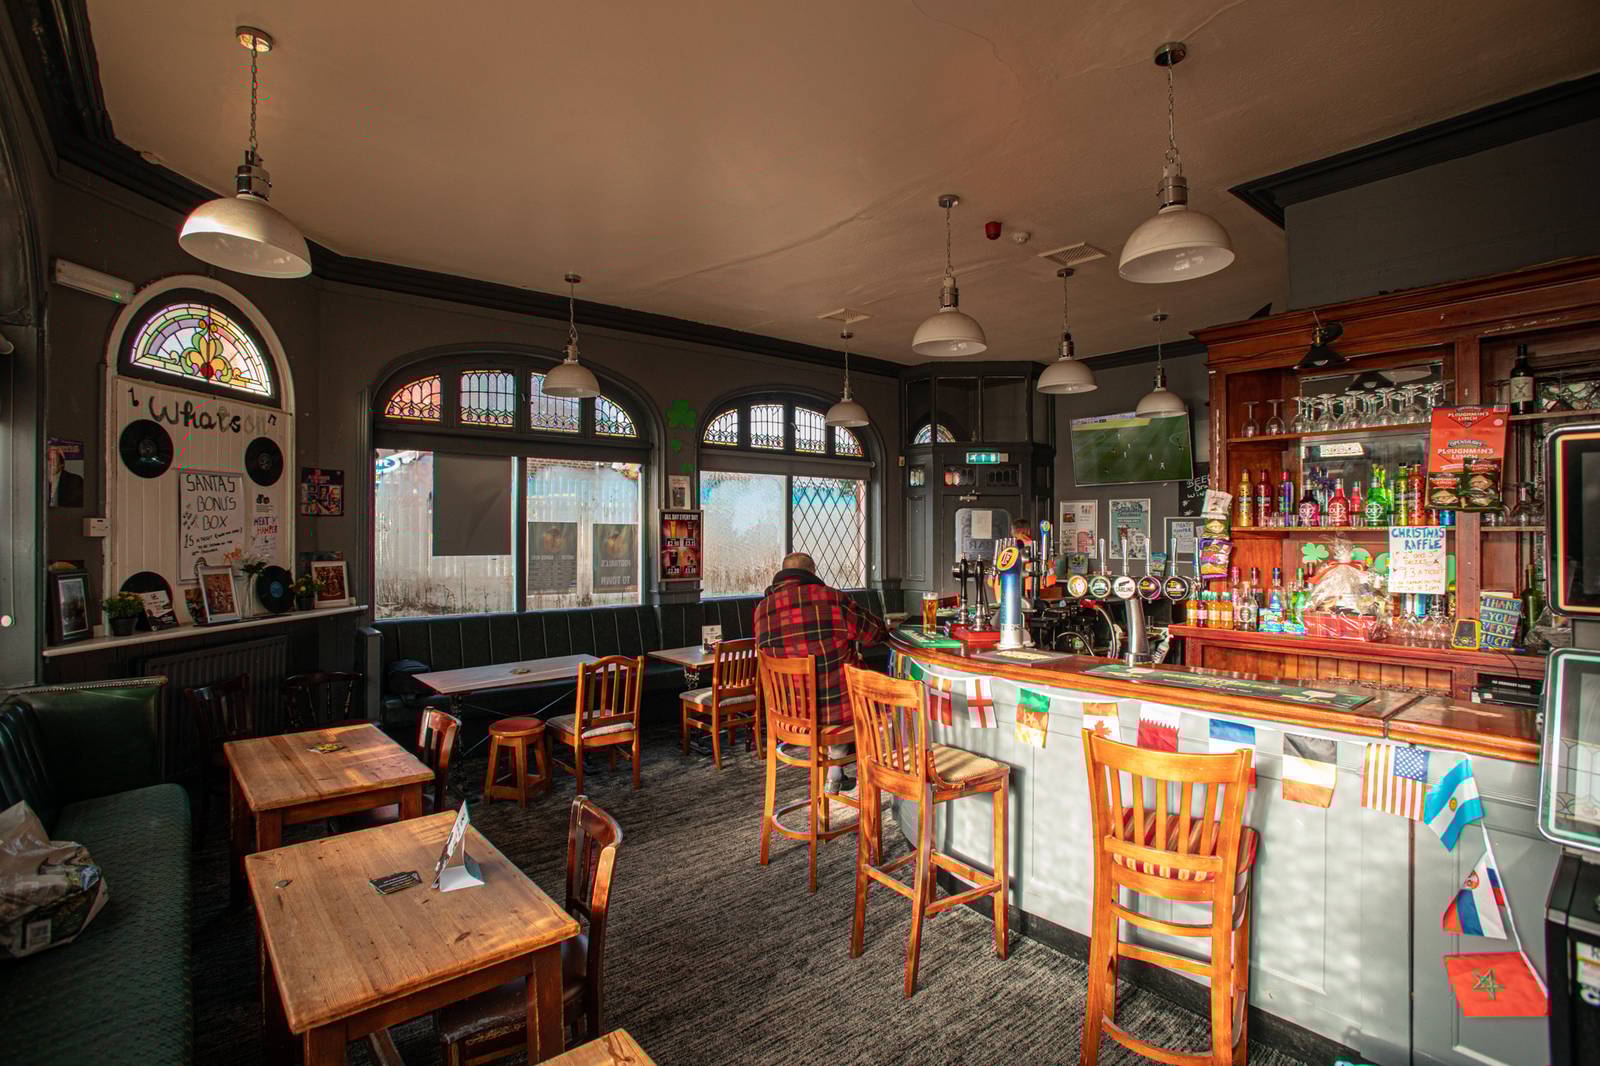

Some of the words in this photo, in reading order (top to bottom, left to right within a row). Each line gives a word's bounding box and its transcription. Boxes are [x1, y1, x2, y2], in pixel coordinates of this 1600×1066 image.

[197, 496, 237, 512] BONUS
[203, 515, 229, 531] BOX
[1391, 527, 1445, 539] CHRISTMAS
[1404, 539, 1443, 550] RAFFLE
[1485, 598, 1520, 611] THANK
